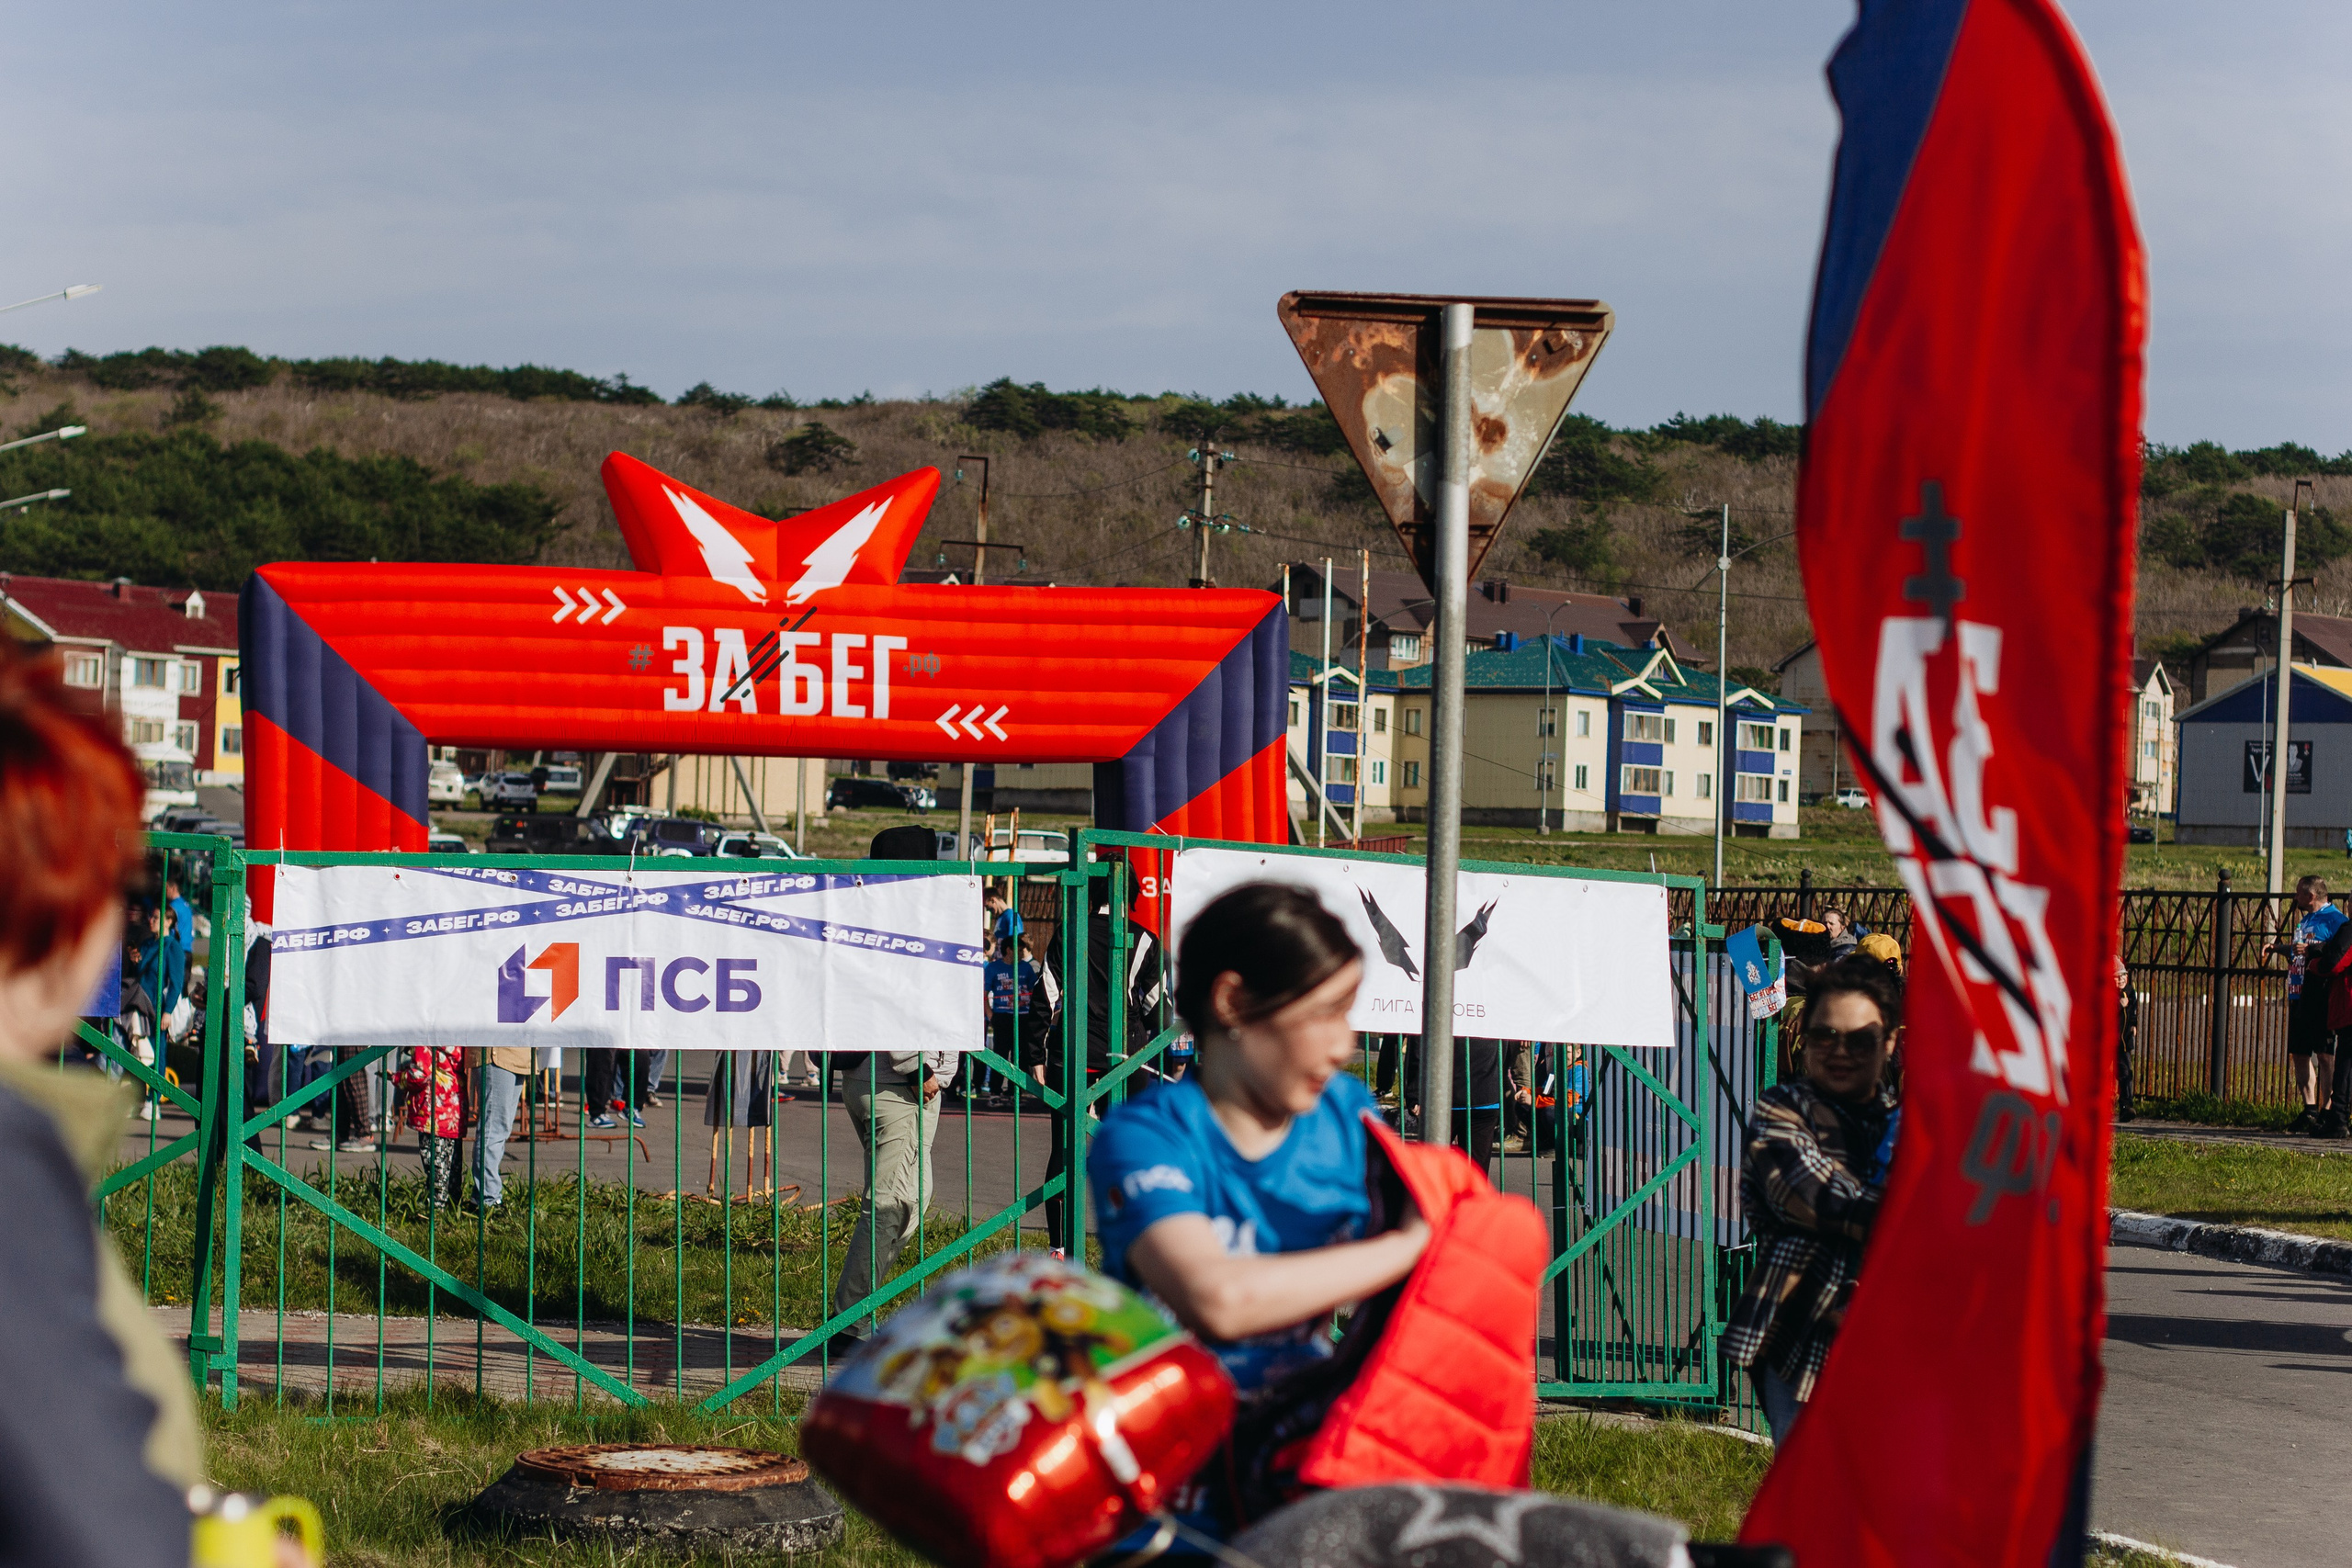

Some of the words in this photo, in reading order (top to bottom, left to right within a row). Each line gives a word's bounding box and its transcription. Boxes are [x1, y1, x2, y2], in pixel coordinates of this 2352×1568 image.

[406, 910, 520, 935] ЗАБЕГ.РФ
[555, 892, 669, 917] ЗАБЕГ.РФ
[704, 875, 816, 900] ЗАБЕГ.РФ
[434, 867, 518, 883] ЕГ.РФ
[684, 904, 791, 930] ЗАБЕГ.РФ
[821, 926, 926, 953] ЗАБЕГ.РФ
[605, 956, 763, 1012] ПСБ
[1372, 998, 1414, 1013] ЛИГА
[1452, 1002, 1486, 1017] ОЕВ
